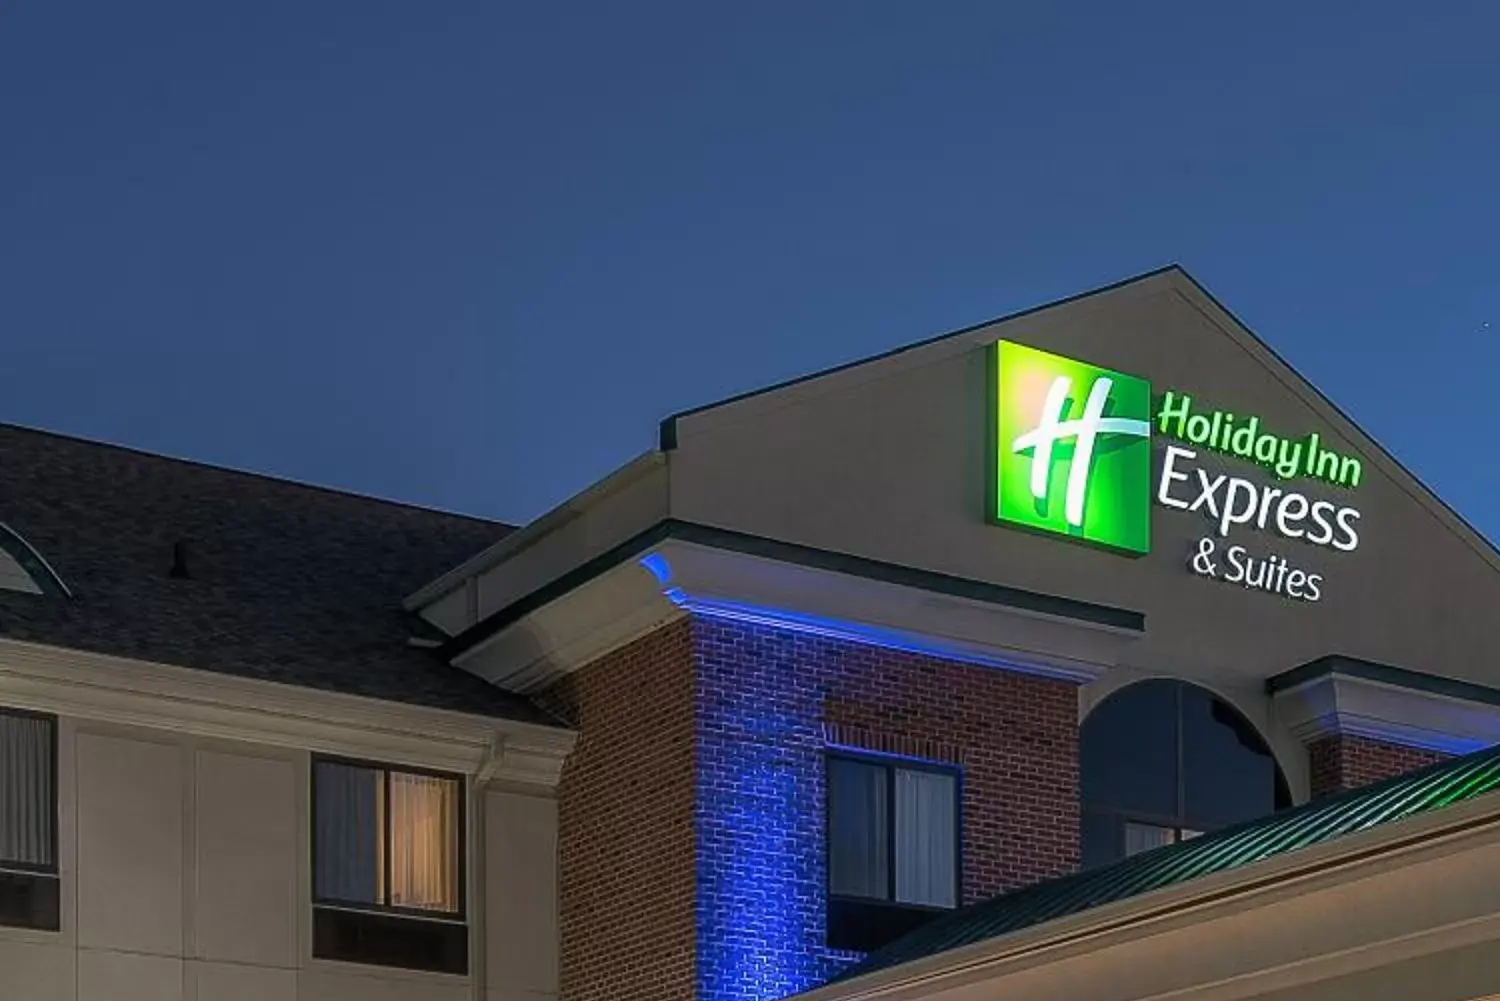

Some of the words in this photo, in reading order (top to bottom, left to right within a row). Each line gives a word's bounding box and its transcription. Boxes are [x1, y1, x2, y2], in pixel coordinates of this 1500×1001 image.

[1158, 391, 1302, 479] Holiday
[1307, 433, 1362, 487] Inn
[1159, 445, 1362, 551] Express
[1193, 538, 1217, 576] &
[1225, 546, 1324, 600] Suites
